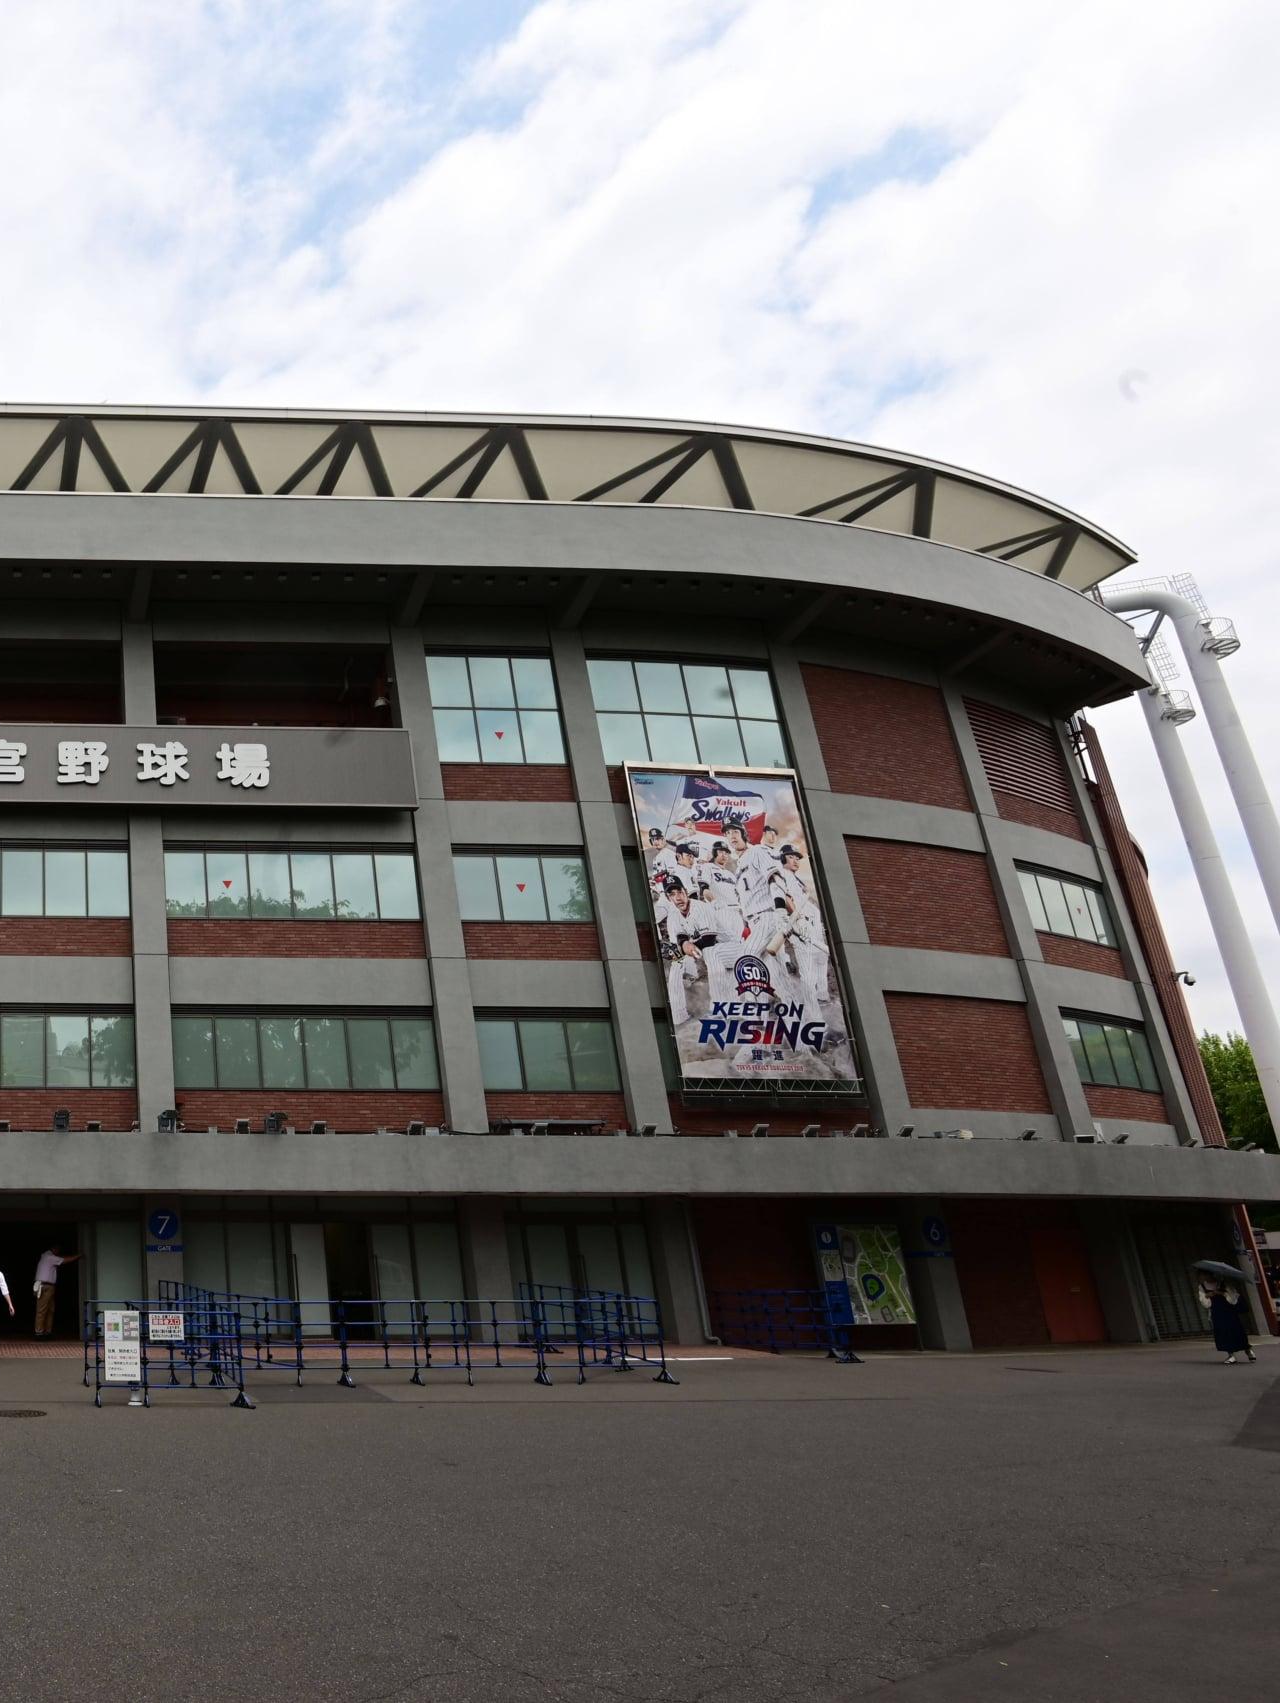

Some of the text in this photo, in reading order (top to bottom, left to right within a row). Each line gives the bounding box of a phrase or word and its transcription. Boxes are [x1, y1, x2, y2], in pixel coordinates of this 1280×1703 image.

[691, 800, 751, 822] Swallows
[715, 797, 747, 807] Yakult
[742, 877, 750, 891] 1
[743, 966, 761, 980] 50
[712, 1001, 804, 1021] KEEP ON
[698, 1018, 826, 1054] RISING
[157, 1215, 171, 1235] 7
[929, 1223, 940, 1241] 6
